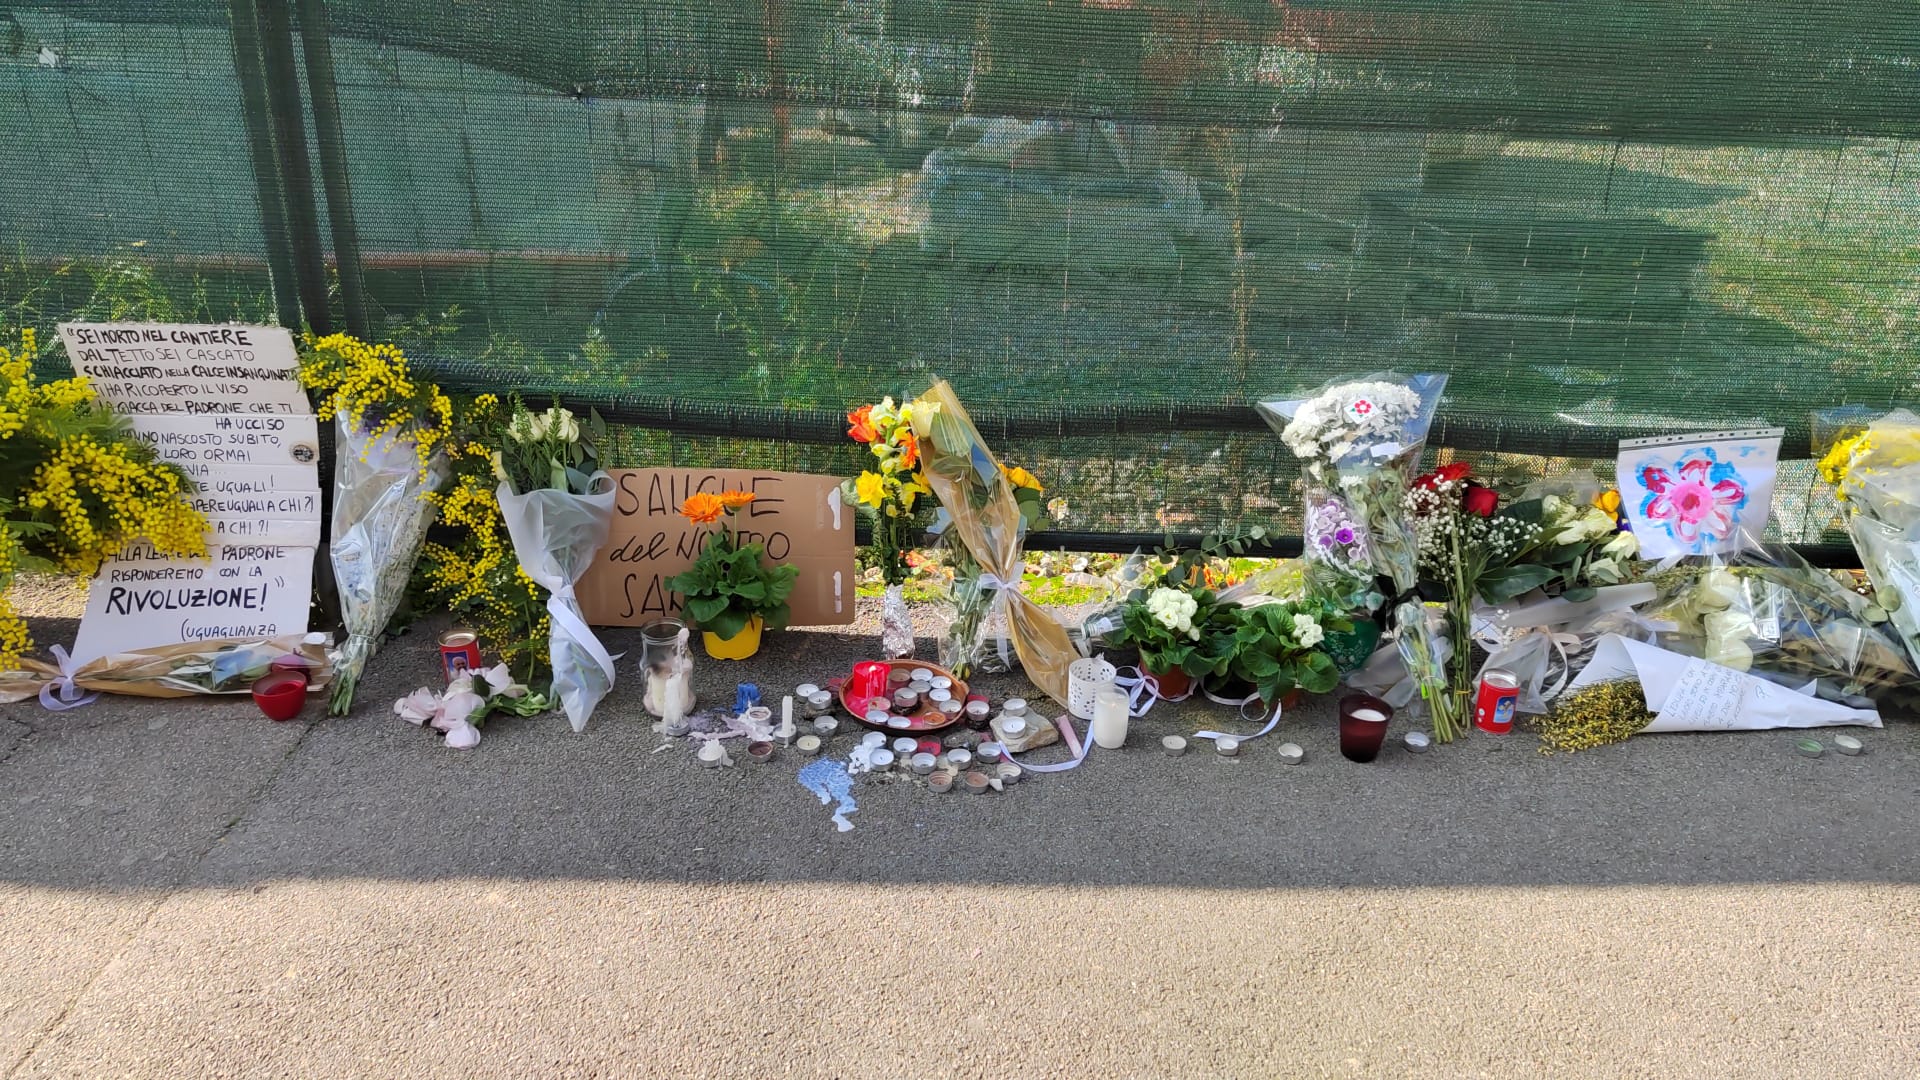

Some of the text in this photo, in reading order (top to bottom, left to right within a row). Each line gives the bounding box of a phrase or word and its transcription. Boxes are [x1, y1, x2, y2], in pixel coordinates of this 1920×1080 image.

[101, 330, 139, 344] MORTO
[142, 329, 167, 342] NEL
[171, 330, 253, 346] CANTIERE
[78, 348, 254, 364] DAL TETTO SEI CASCATO
[83, 365, 163, 379] SCHIACCIATO
[165, 368, 190, 378] NELLA
[191, 365, 226, 378] CALCE
[106, 383, 122, 398] HA
[124, 383, 198, 398] RICOPERTO
[201, 384, 214, 394] IL
[216, 384, 248, 394] VISO
[161, 402, 184, 412] DEL
[185, 401, 244, 414] PADRONE
[249, 403, 274, 414] CHE
[277, 403, 292, 414] TI
[216, 418, 284, 431] HA UCCISO
[162, 433, 222, 445] NASCOSTO
[228, 434, 281, 448] SUBITO,
[164, 448, 197, 459] LORO
[204, 448, 251, 462] ORMAI
[267, 501, 276, 512] A
[218, 521, 225, 534] A
[610, 527, 790, 563] del NOTO
[221, 546, 286, 561] PADRONE
[111, 566, 262, 583] RISPONDEREMO CON LA
